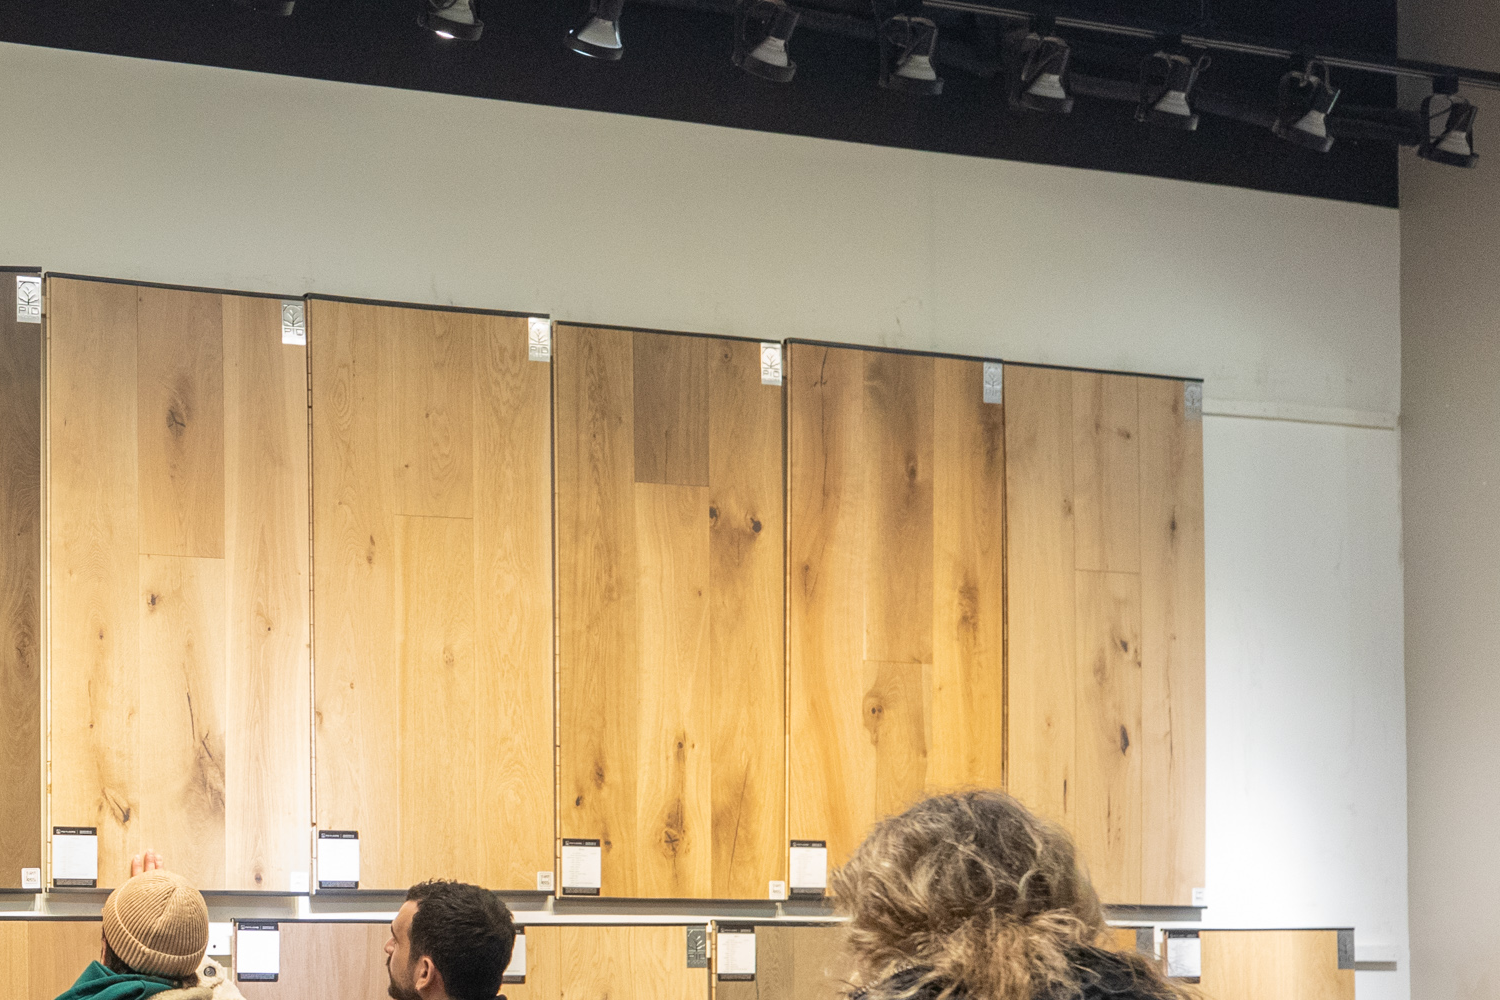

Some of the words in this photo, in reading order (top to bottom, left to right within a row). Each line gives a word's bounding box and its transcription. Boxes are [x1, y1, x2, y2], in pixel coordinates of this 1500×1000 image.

[18, 306, 40, 315] PID
[284, 327, 304, 336] PID
[530, 346, 548, 354] PID
[762, 370, 780, 378] PID
